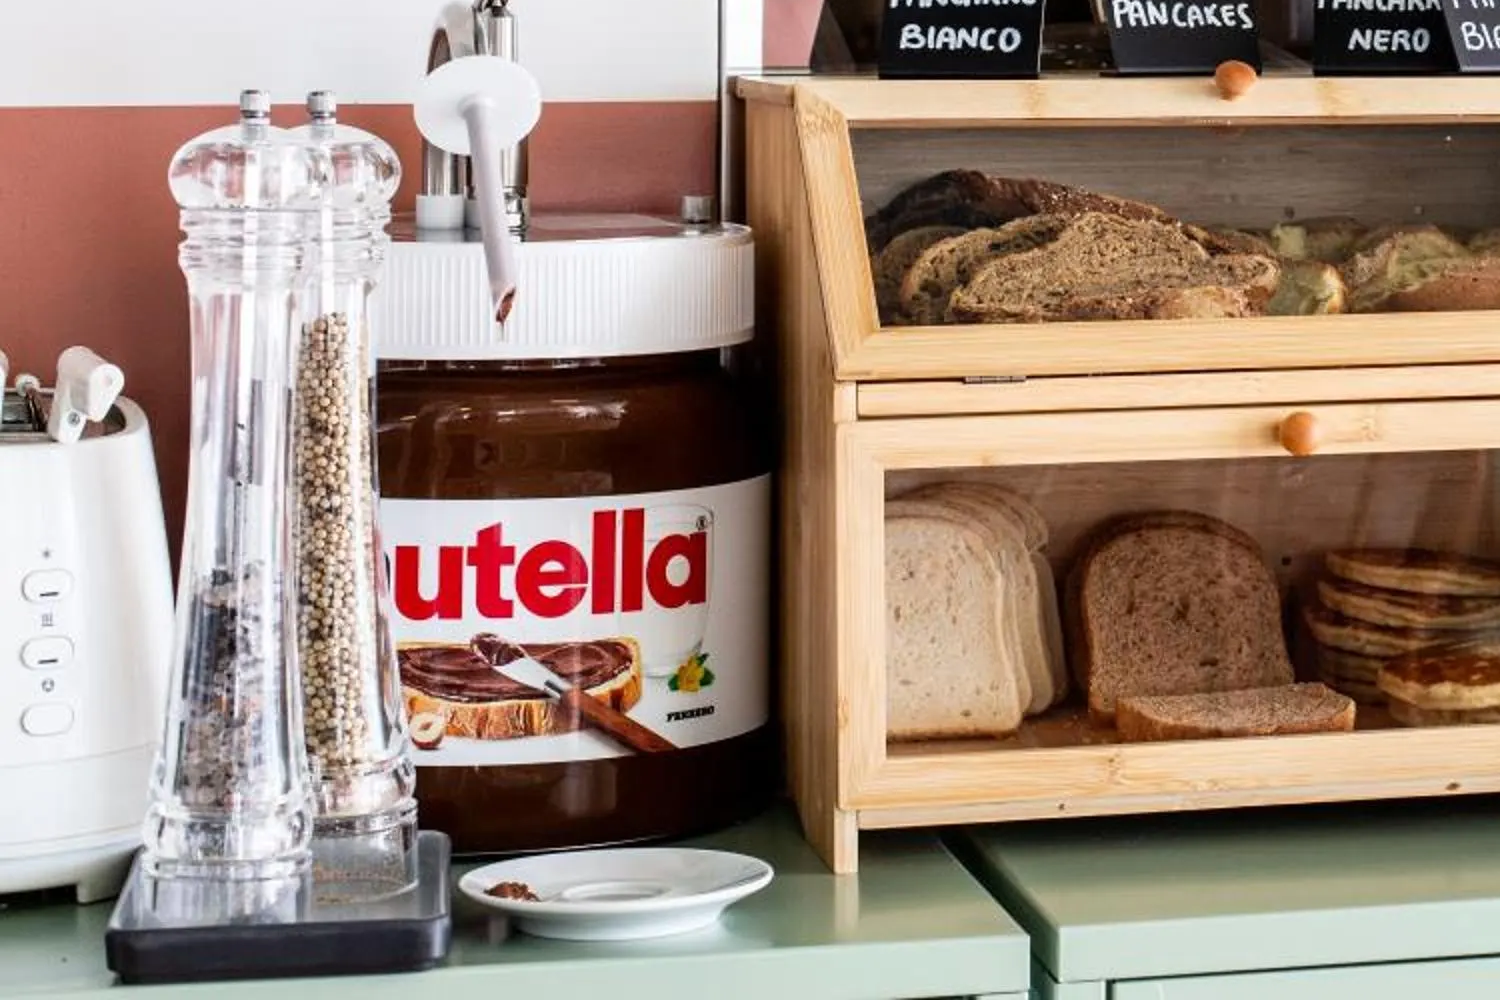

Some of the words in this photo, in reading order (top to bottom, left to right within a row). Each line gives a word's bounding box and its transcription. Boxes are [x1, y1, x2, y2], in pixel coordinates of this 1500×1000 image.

[900, 23, 1022, 53] BIANCO
[1348, 27, 1432, 53] NERO
[384, 507, 708, 621] utella
